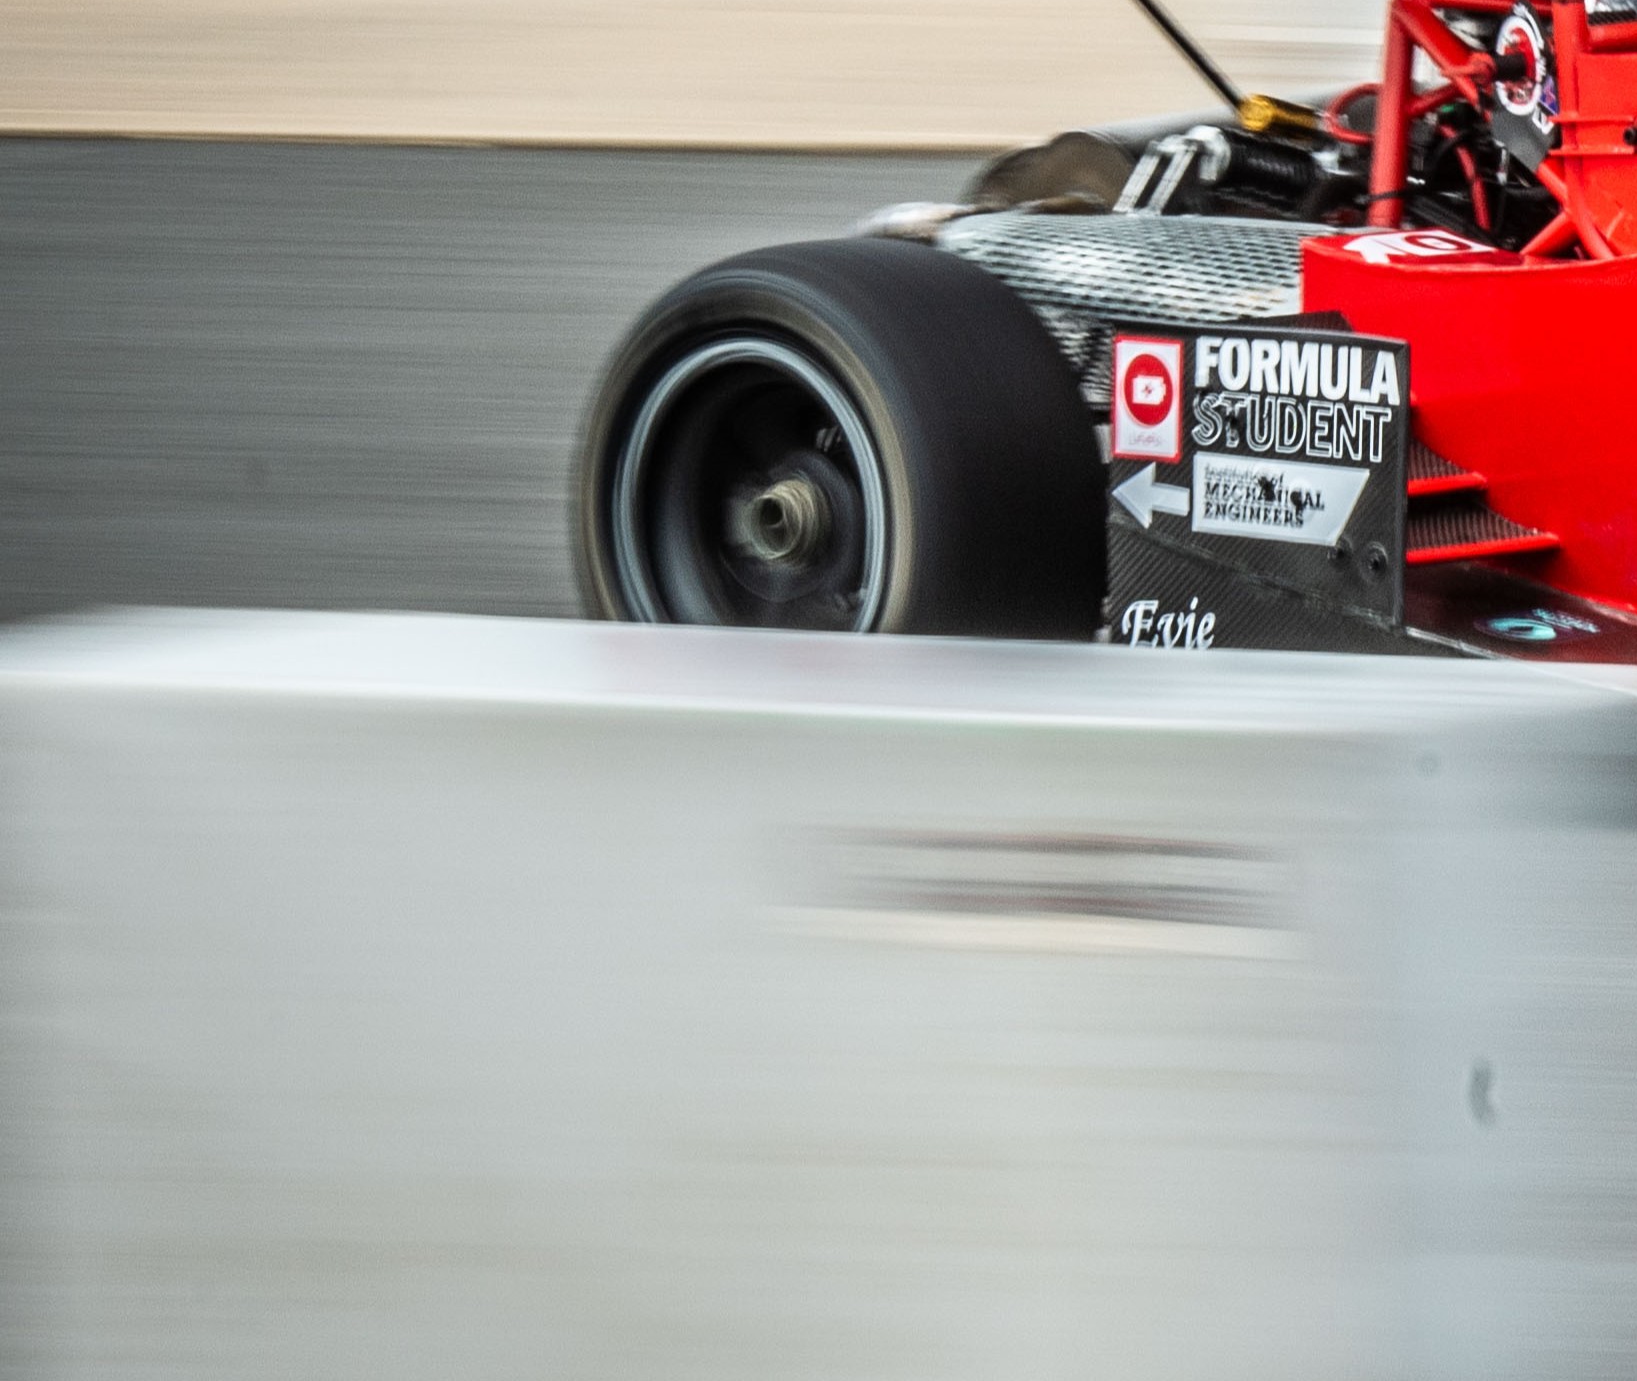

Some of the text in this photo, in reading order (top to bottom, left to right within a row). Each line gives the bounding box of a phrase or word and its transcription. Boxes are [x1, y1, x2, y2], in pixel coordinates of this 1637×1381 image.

[1194, 335, 1401, 407] FORMULA
[1191, 390, 1393, 464] STUDENT
[1203, 500, 1305, 529] ENGINEERS
[1121, 596, 1216, 649] Evie
